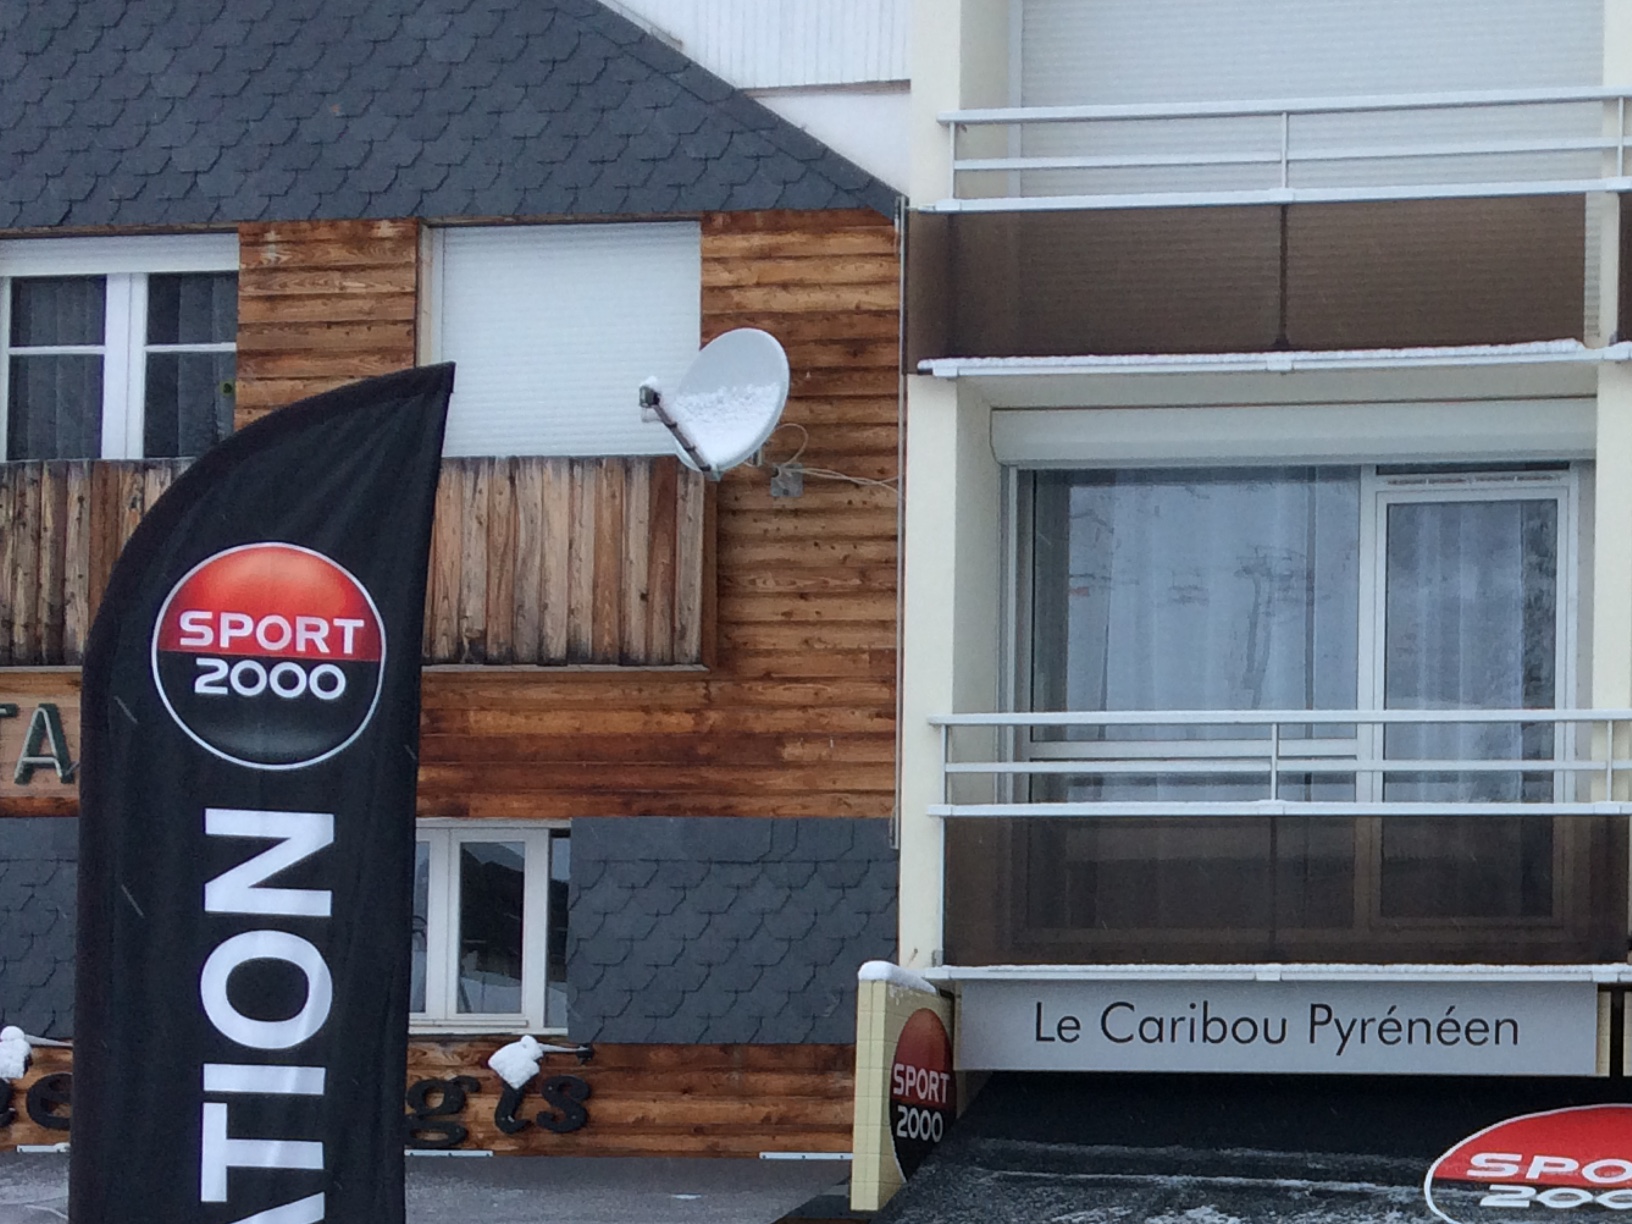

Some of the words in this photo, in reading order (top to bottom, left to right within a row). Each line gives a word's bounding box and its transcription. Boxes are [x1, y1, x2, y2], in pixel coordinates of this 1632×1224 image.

[179, 609, 365, 655] SPORT
[194, 657, 346, 701] 2000
[1035, 1002, 1081, 1045] Le
[1100, 1002, 1288, 1046] Caribou
[1309, 1003, 1520, 1056] Pyrénéen
[893, 1063, 950, 1103] SPORT
[896, 1105, 943, 1143] 2000
